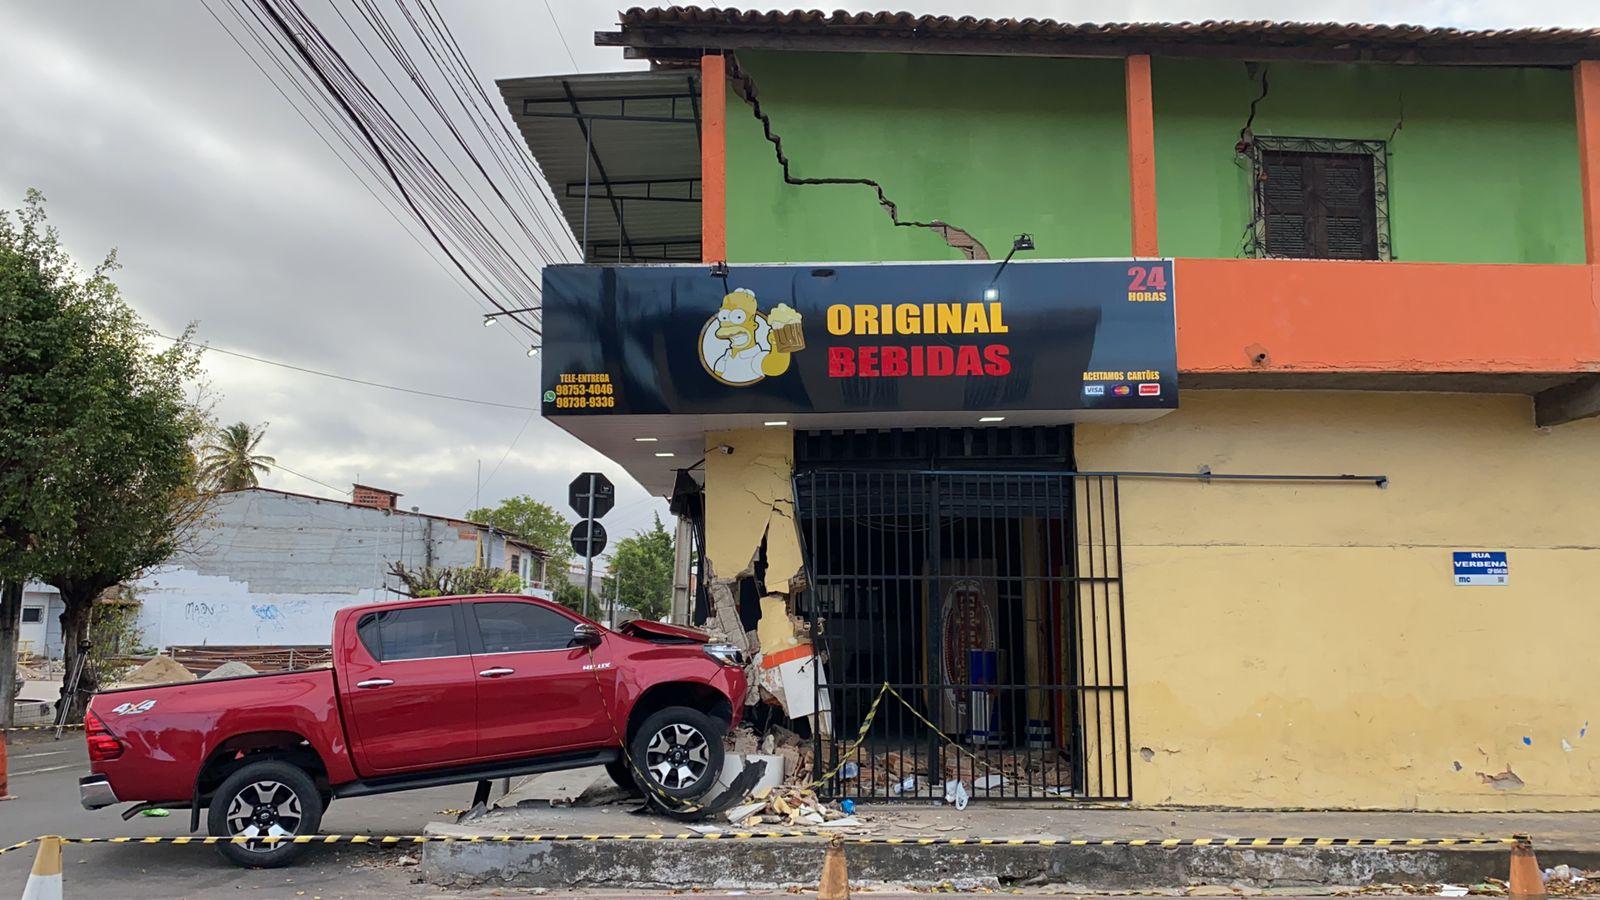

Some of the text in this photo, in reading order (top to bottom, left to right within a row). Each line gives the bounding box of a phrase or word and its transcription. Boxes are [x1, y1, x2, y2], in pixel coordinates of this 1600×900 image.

[1128, 267, 1167, 290] 24
[1128, 292, 1167, 302] HORAS
[827, 303, 1009, 335] ORIGINAL
[828, 345, 1011, 377] BEBIDAS
[560, 374, 610, 383] TELE-ENTREGA
[1083, 370, 1160, 381] ACEITAMOS CARTÕES
[556, 384, 613, 395] 98753-4046
[557, 397, 614, 408] 98738-9336
